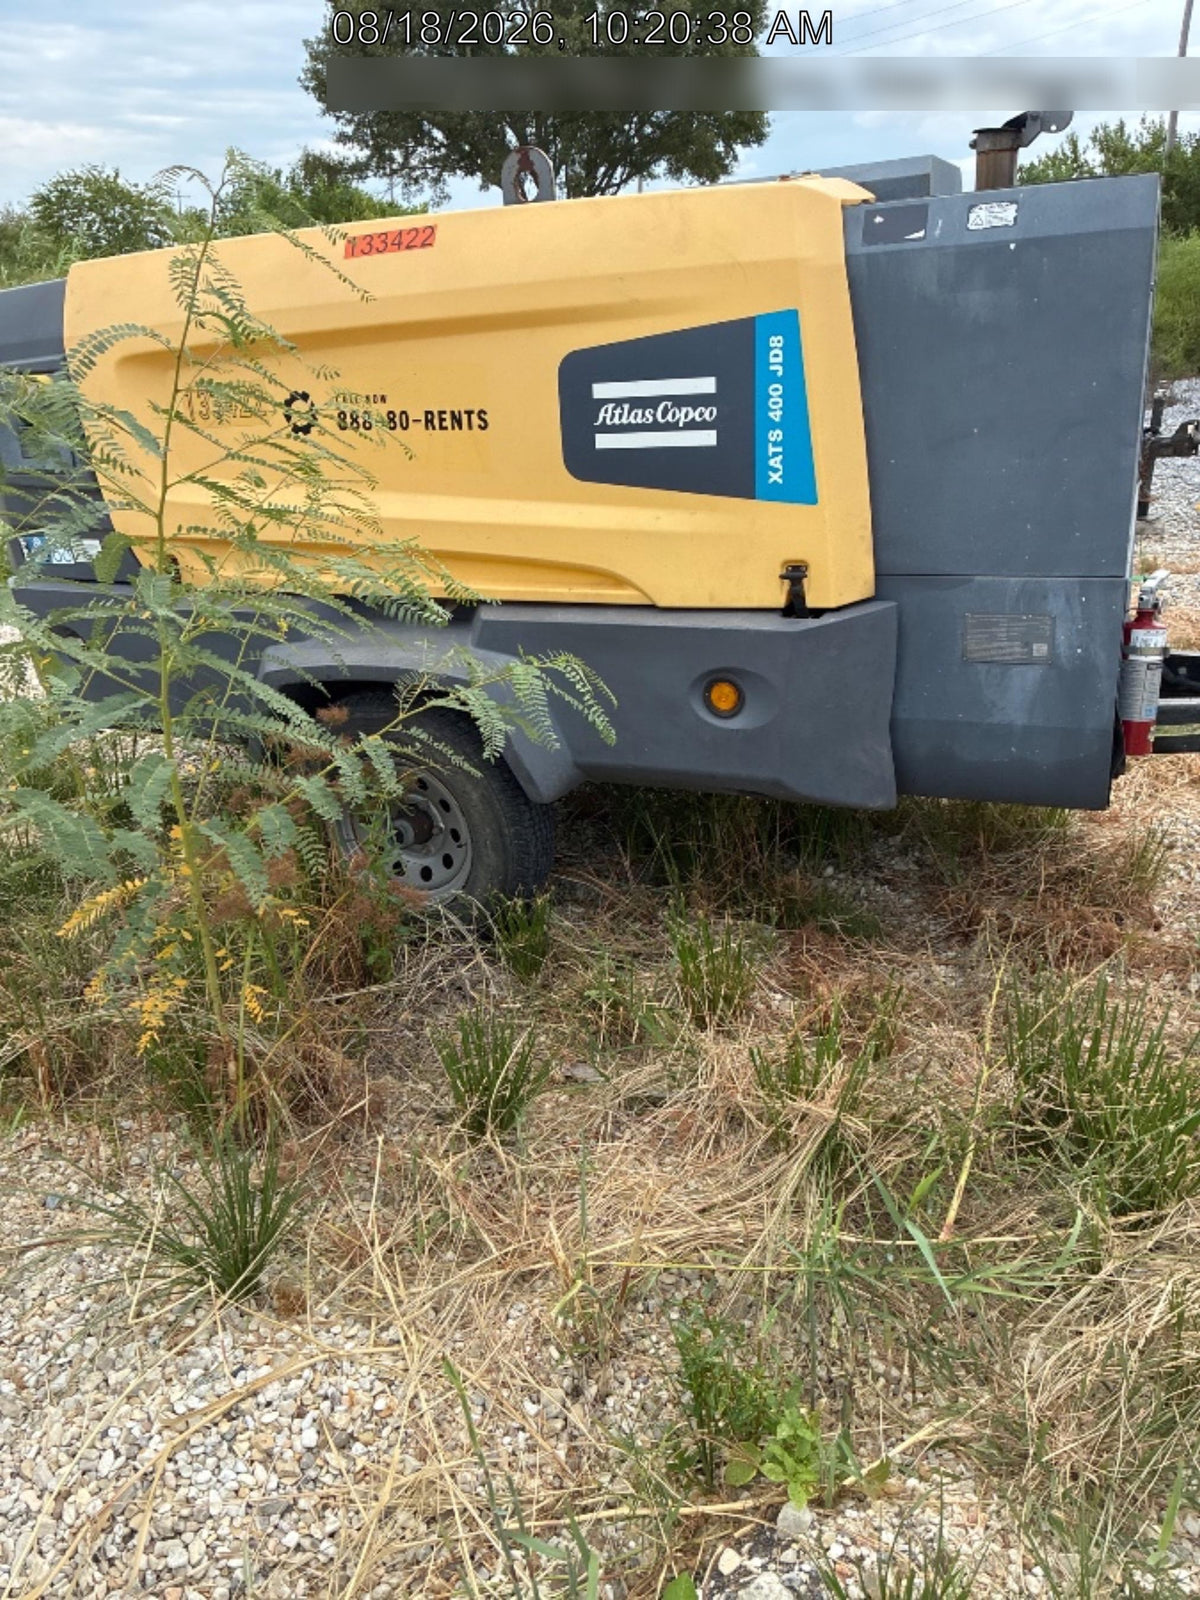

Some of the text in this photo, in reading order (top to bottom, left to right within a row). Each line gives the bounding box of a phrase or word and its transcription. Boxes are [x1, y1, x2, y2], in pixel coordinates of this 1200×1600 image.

[347, 225, 435, 256] 133422
[337, 409, 489, 431] 88880-RENTS
[593, 401, 718, 427] Atlas Copco
[768, 335, 785, 485] XATS 400 JD8
